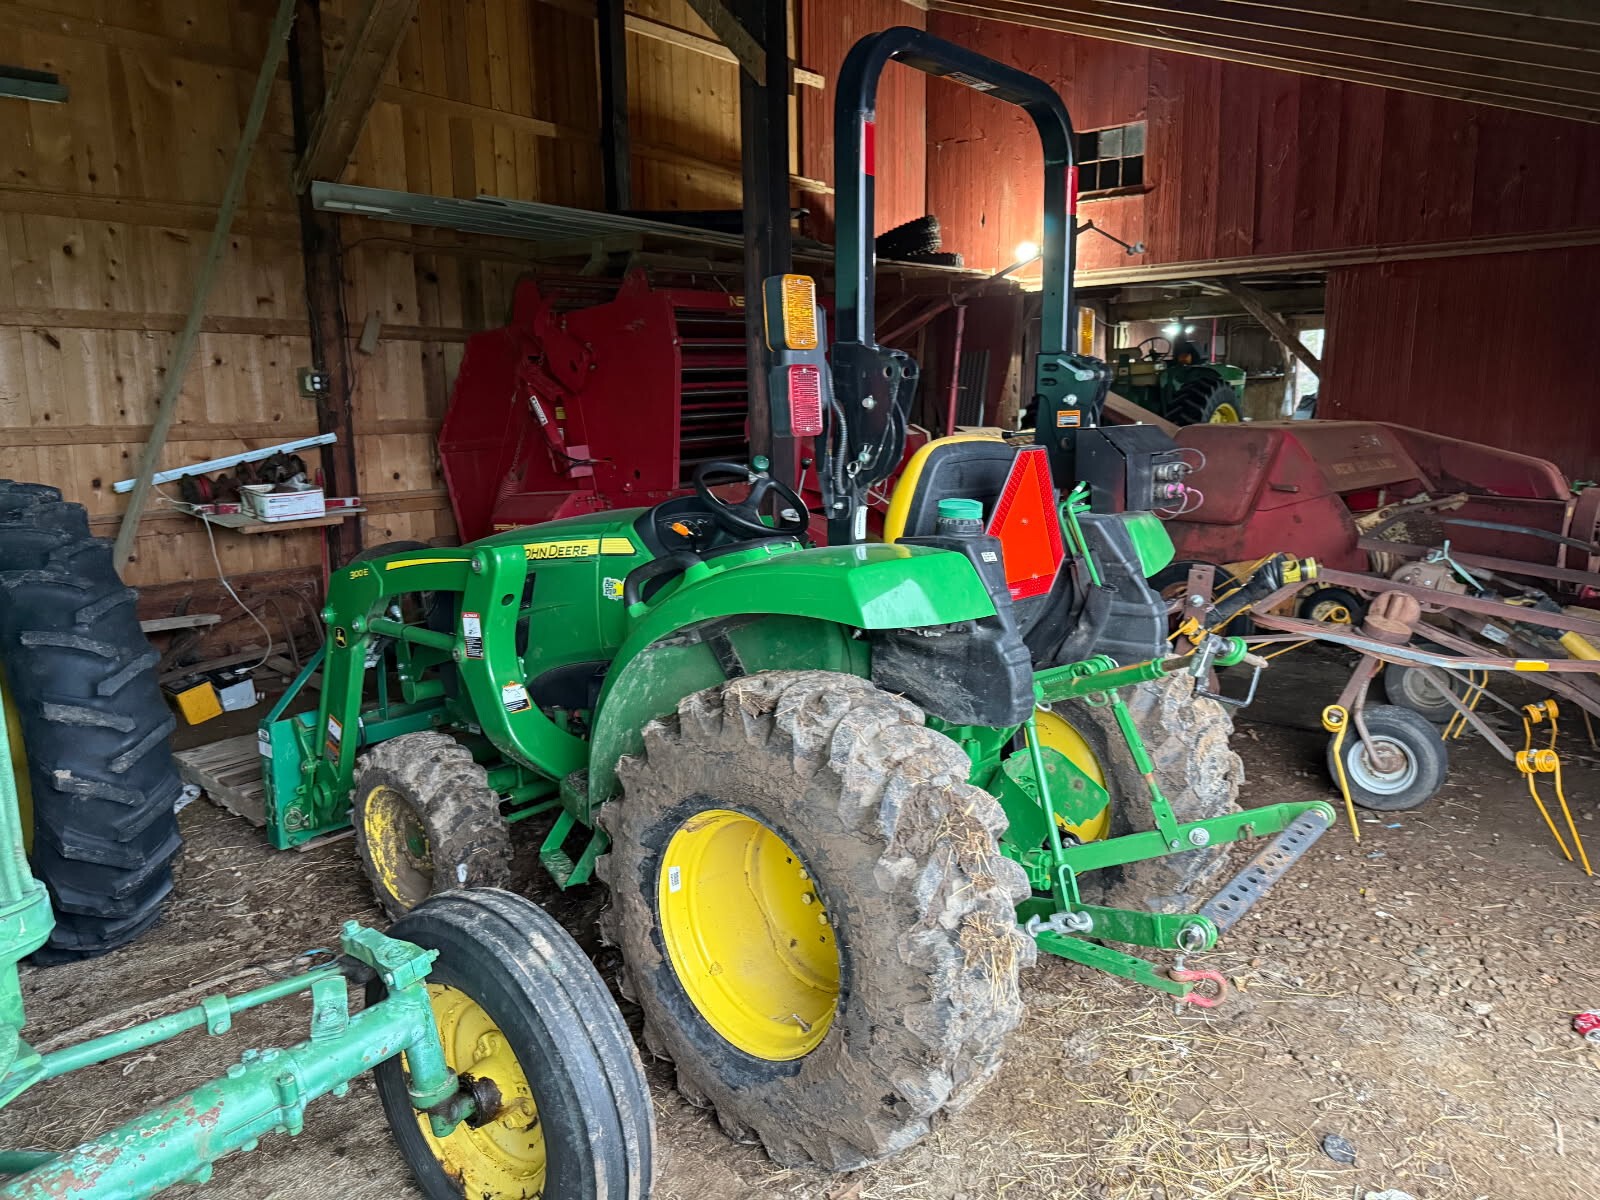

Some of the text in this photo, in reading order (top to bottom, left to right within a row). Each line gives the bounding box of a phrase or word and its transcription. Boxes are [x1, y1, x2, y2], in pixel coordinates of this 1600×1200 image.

[729, 295, 745, 307] NE
[525, 544, 589, 559] OHN DEERE
